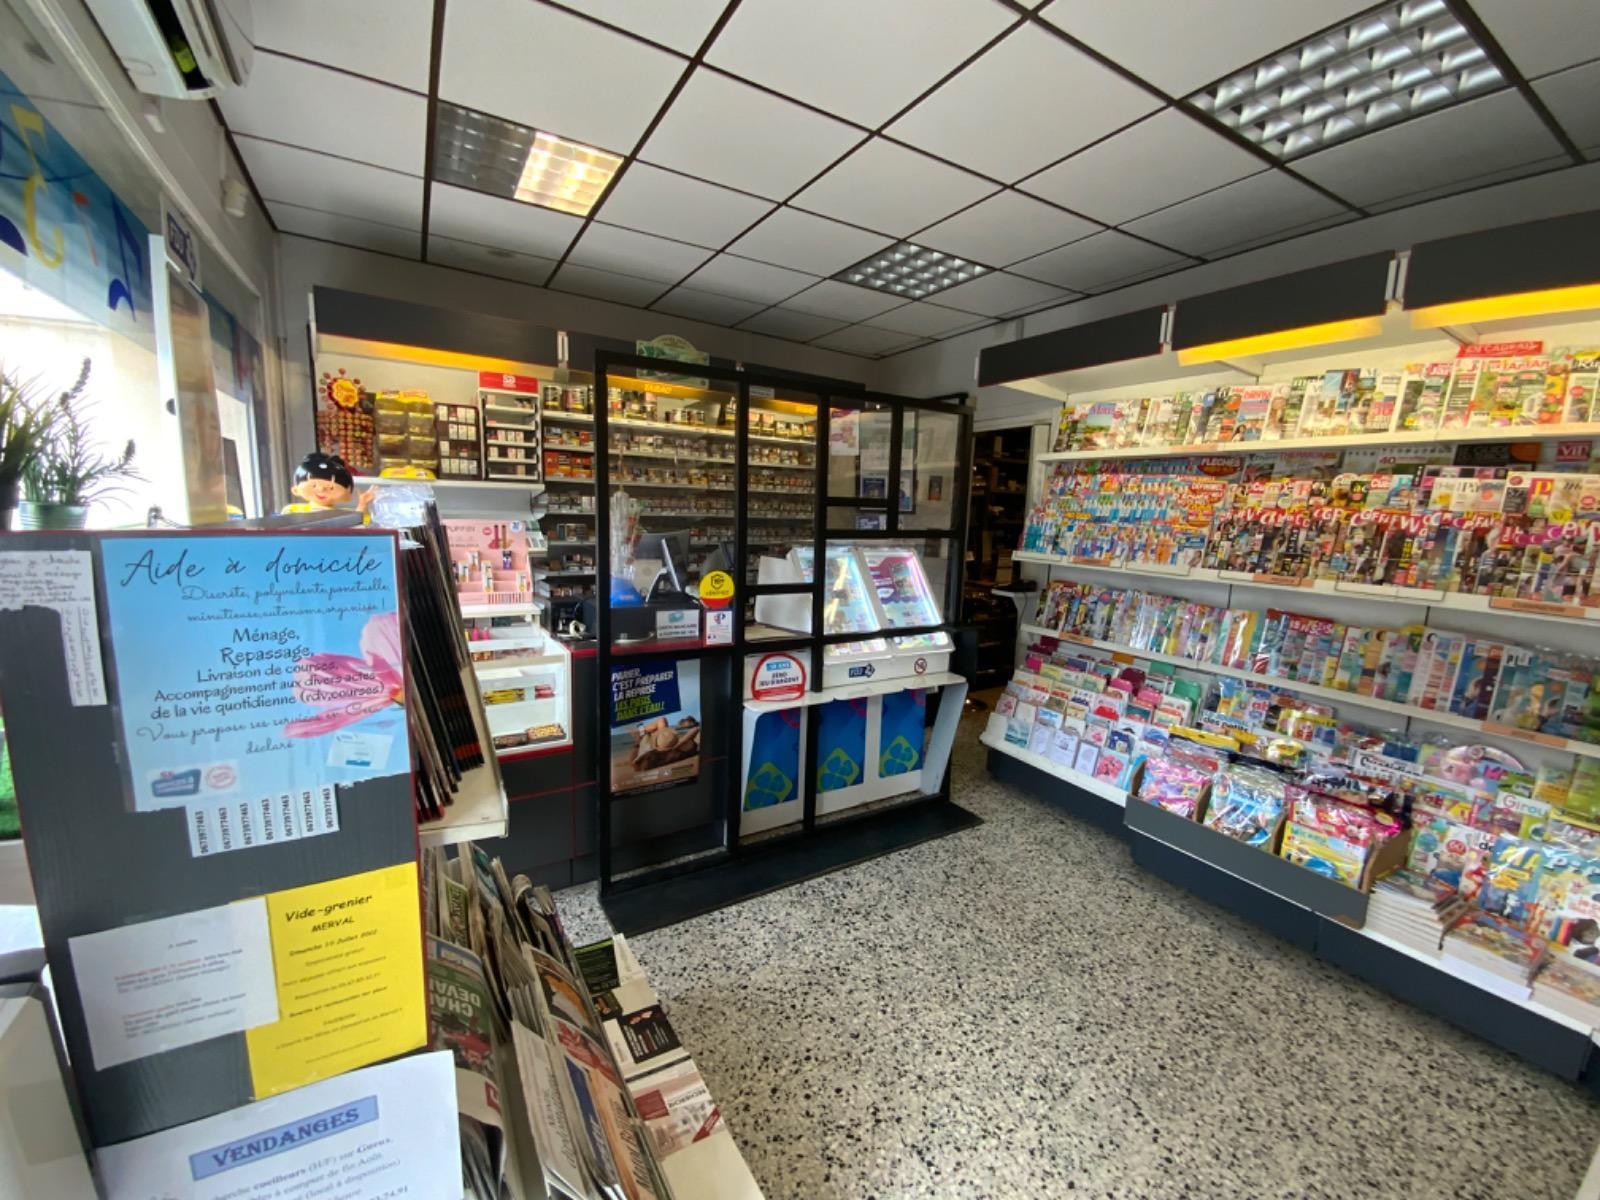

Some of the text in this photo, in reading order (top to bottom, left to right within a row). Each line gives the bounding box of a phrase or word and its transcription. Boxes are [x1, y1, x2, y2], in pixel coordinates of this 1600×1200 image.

[120, 548, 205, 587] Aide
[266, 546, 382, 582] domicile
[232, 628, 300, 645] Ménage,
[220, 645, 315, 667] Repassage,
[197, 666, 261, 683] Livraison
[265, 664, 282, 677] de
[154, 680, 276, 703] Accompagnement
[280, 678, 301, 690] aux
[150, 706, 172, 720] de
[175, 702, 187, 717] la
[190, 701, 211, 715] vie
[215, 694, 296, 716] quotidienne
[191, 723, 246, 744] propose
[285, 894, 373, 922] Vide-grenier
[311, 916, 355, 933] MERVAL
[212, 1107, 360, 1168] VENDANGES
